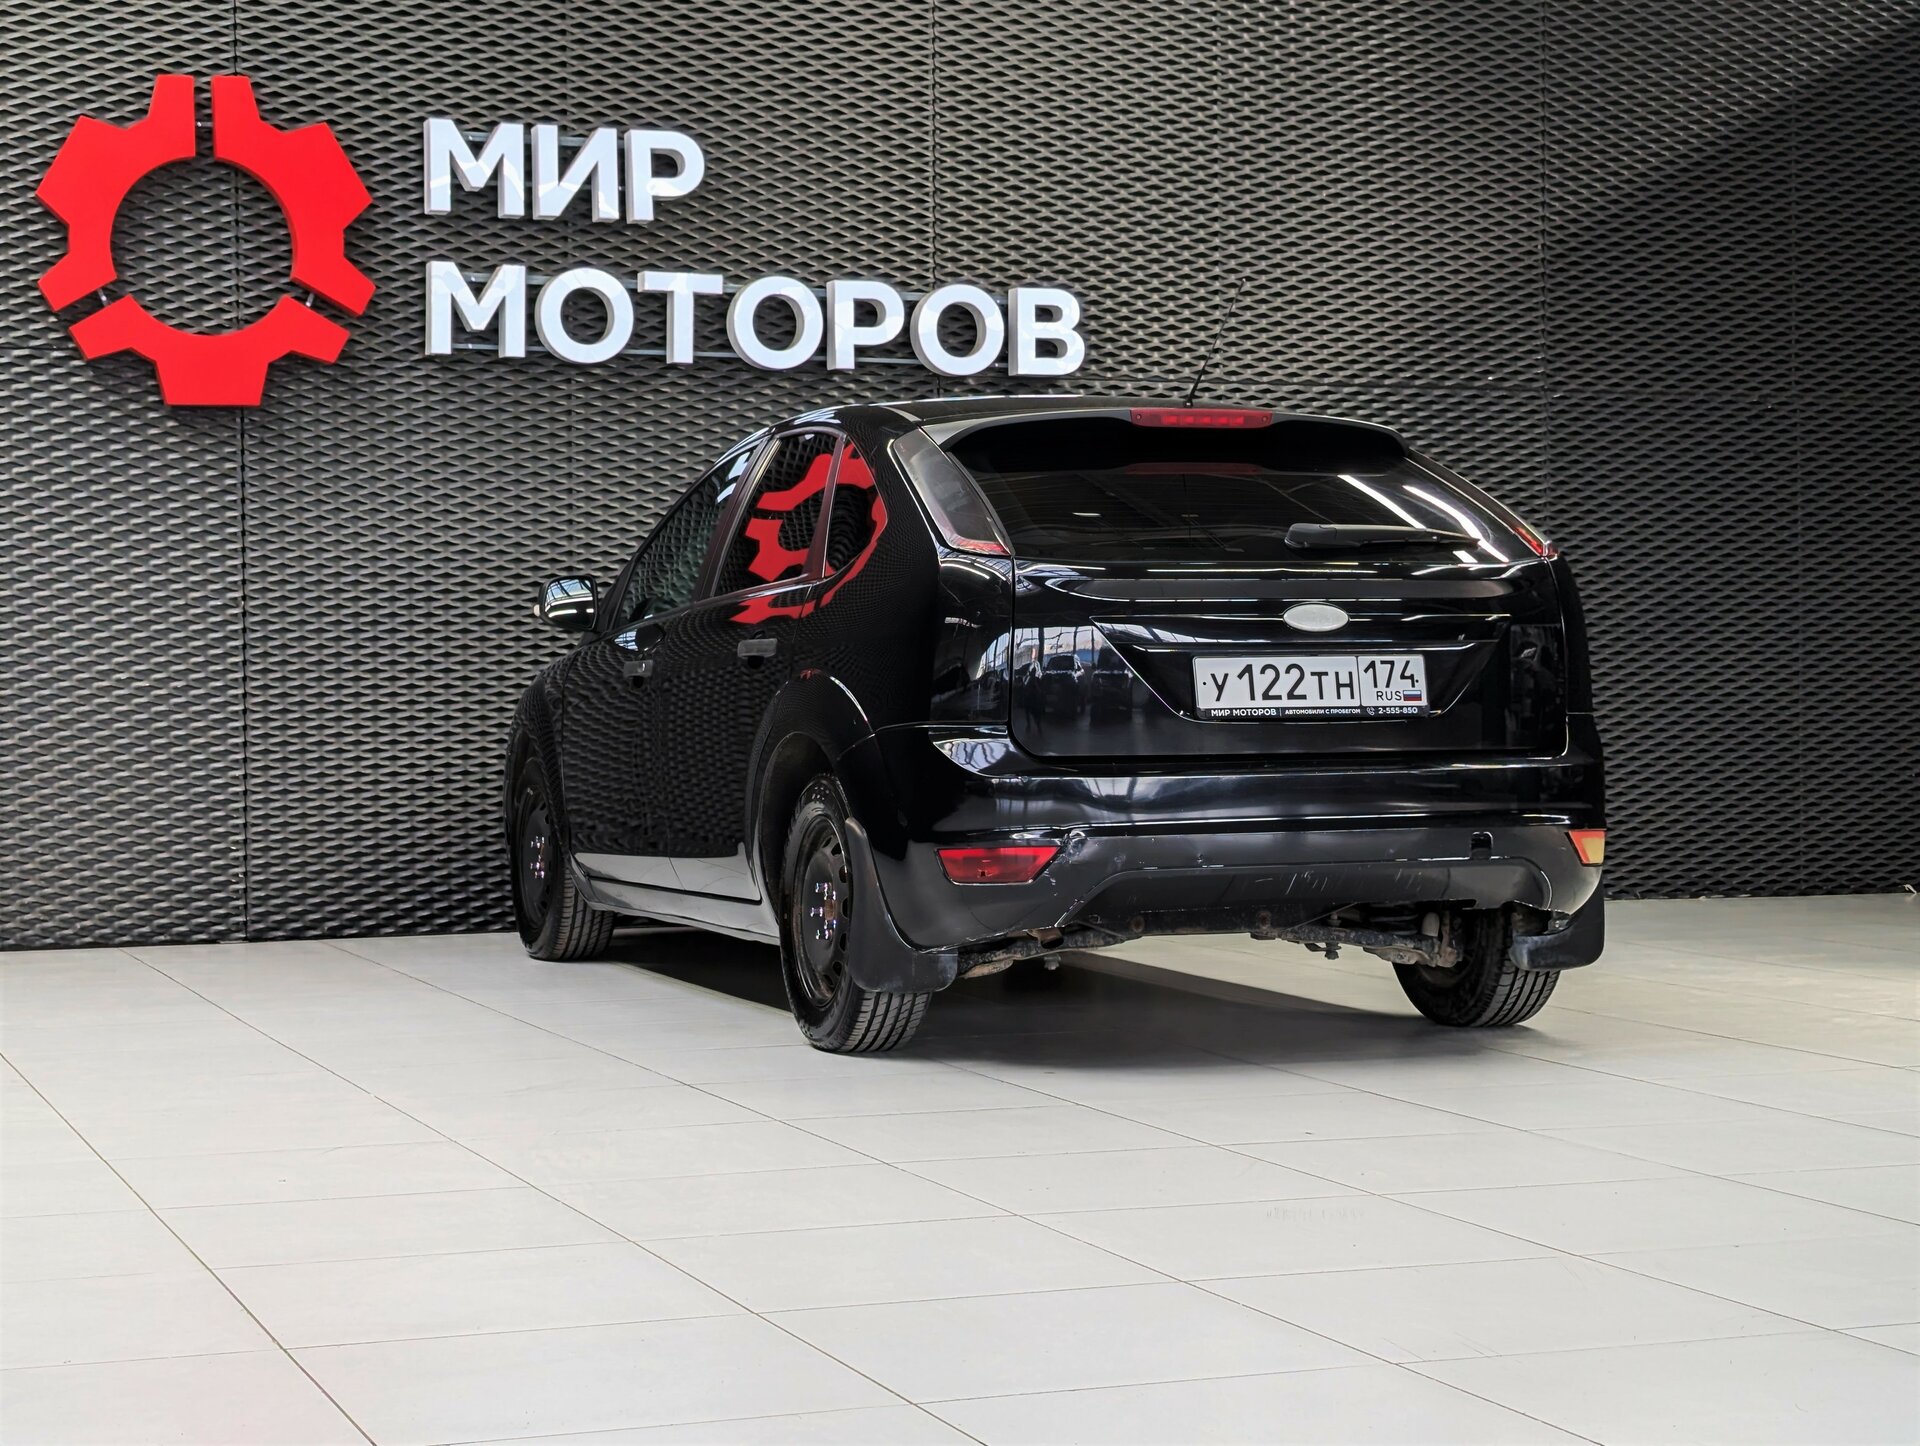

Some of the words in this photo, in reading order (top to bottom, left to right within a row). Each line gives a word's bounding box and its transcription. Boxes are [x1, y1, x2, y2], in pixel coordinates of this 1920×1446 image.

[423, 117, 705, 224] МИР
[424, 260, 1086, 378] МОТОРОВ
[1363, 660, 1415, 689] 174
[1376, 690, 1402, 701] RUS
[1211, 709, 1231, 717] МИР
[1232, 708, 1277, 716] МОТОРОВ
